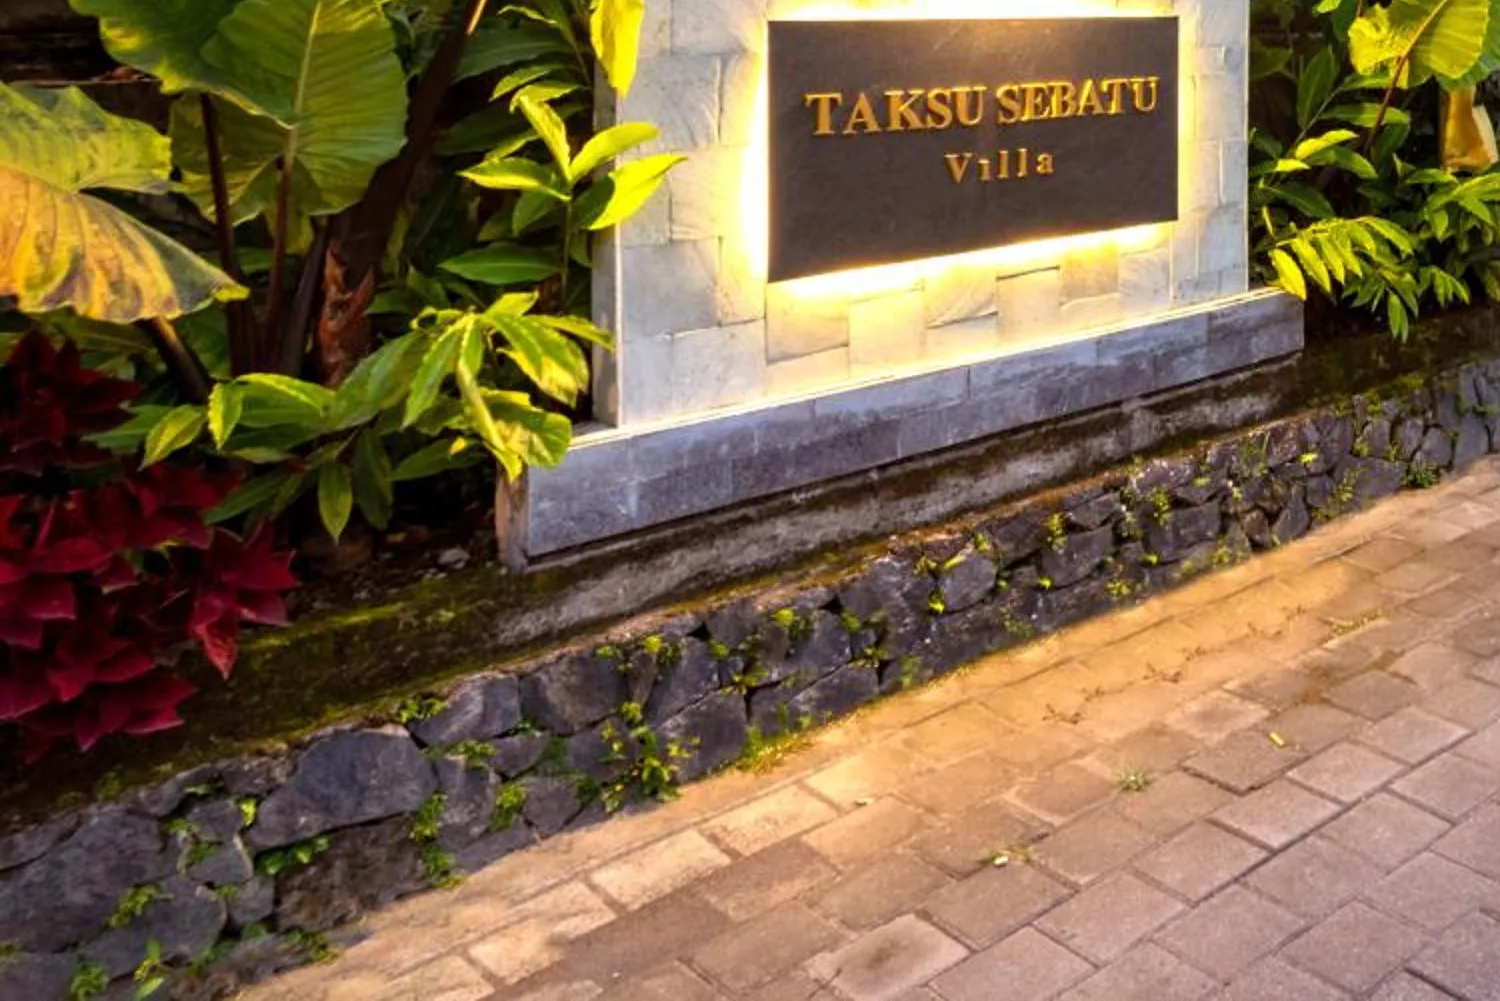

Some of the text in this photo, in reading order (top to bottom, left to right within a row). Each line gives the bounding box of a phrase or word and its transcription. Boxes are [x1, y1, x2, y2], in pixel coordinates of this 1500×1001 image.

[805, 76, 1160, 136] TAKSU SEBATU
[944, 147, 1055, 183] Villa
